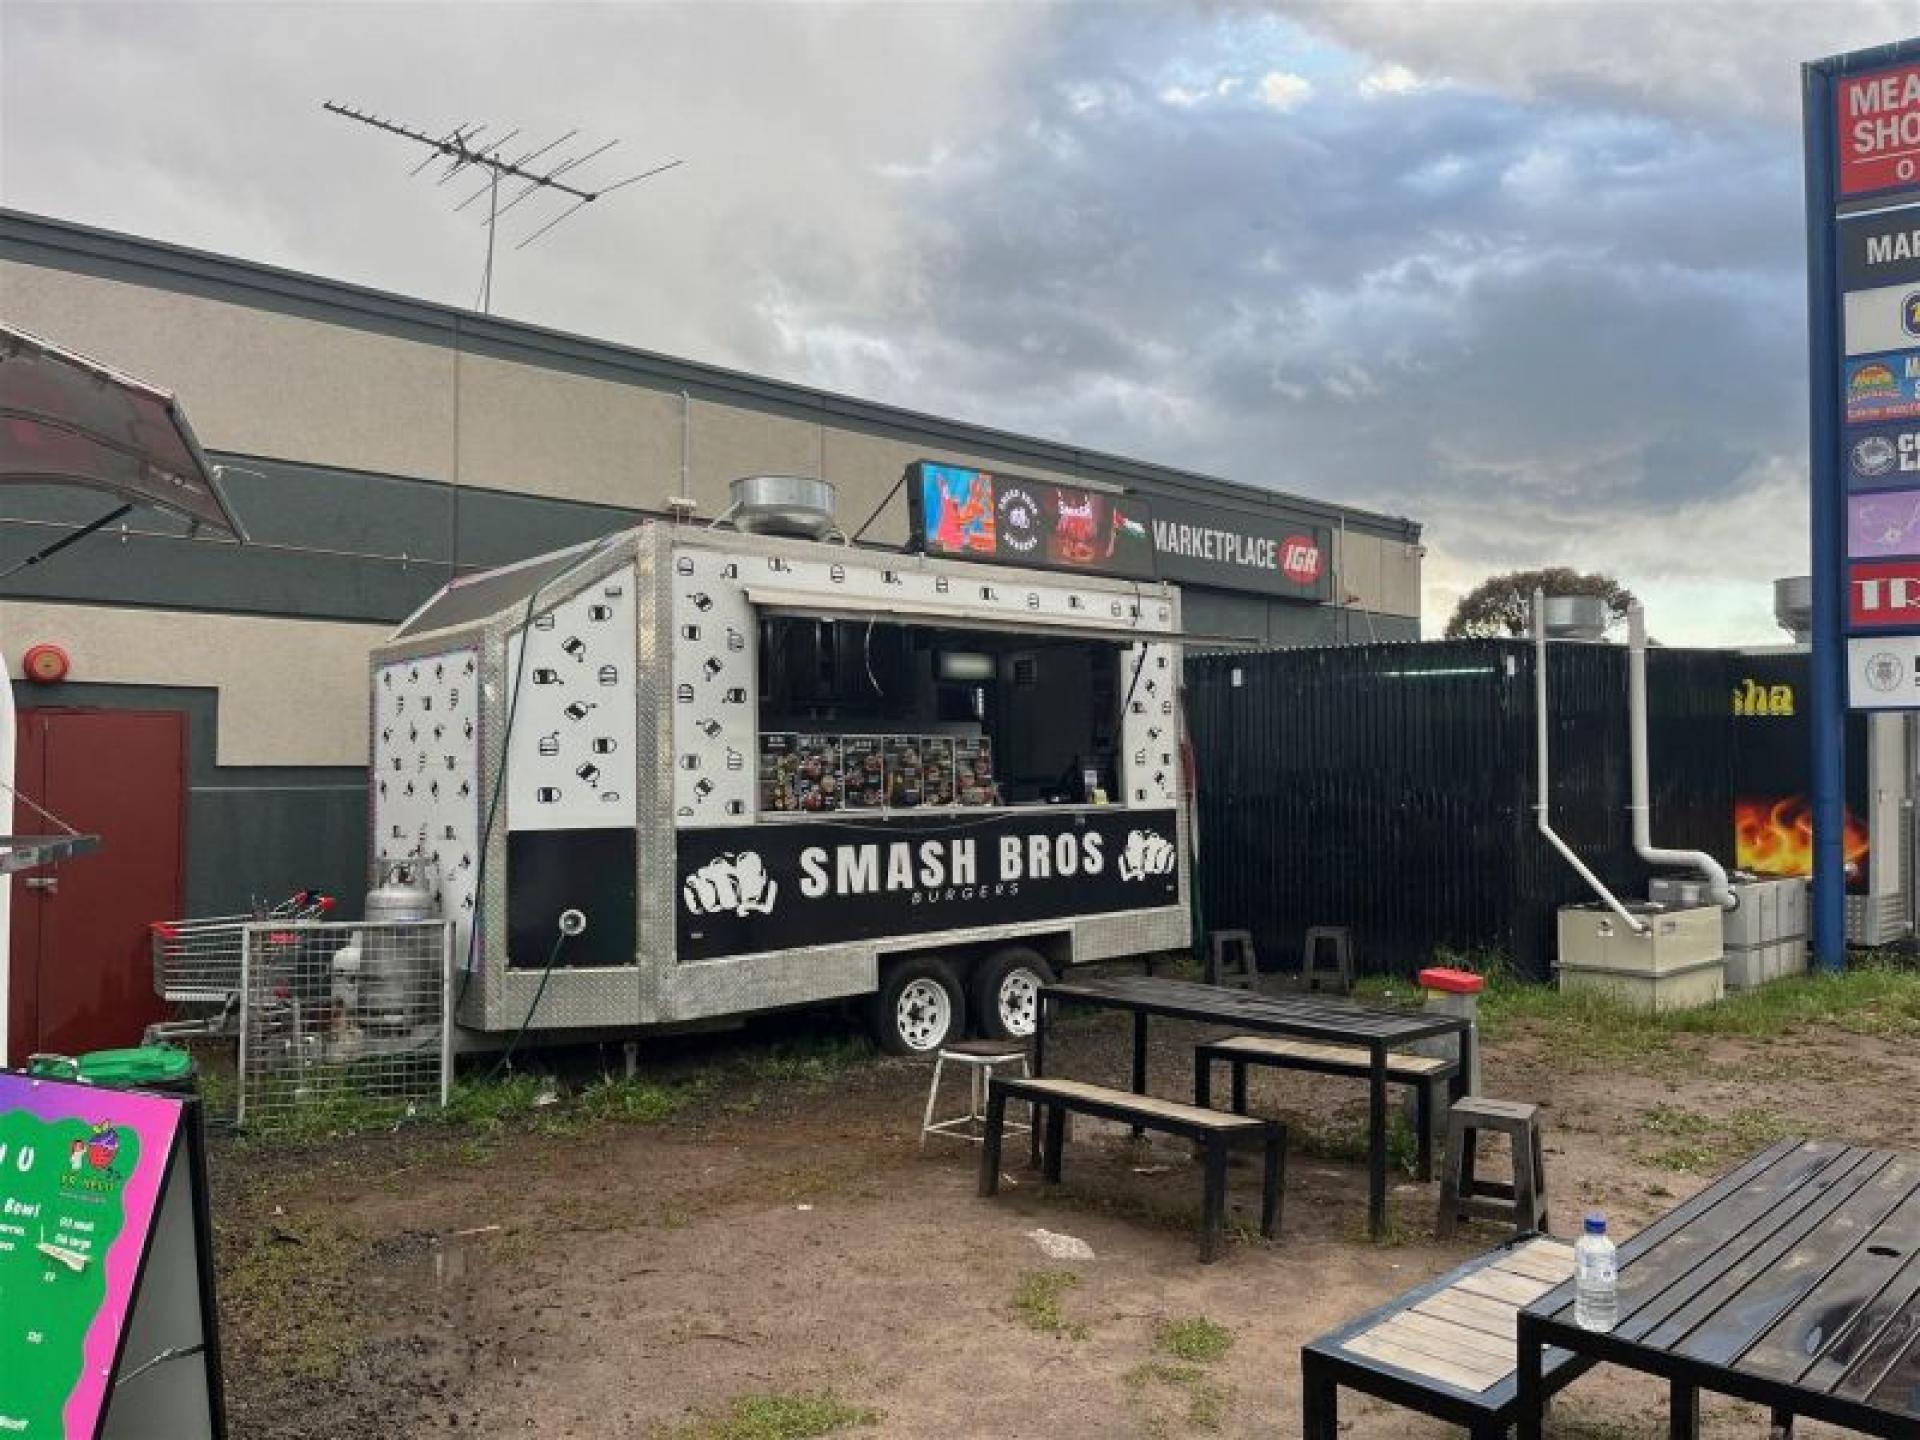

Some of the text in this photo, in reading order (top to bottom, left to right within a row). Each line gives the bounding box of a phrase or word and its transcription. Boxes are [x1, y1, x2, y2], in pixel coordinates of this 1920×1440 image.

[1152, 518, 1318, 574] MARKETPLACE IGA
[800, 832, 1104, 898] SMASH BROS
[911, 882, 1019, 905] BURGERS
